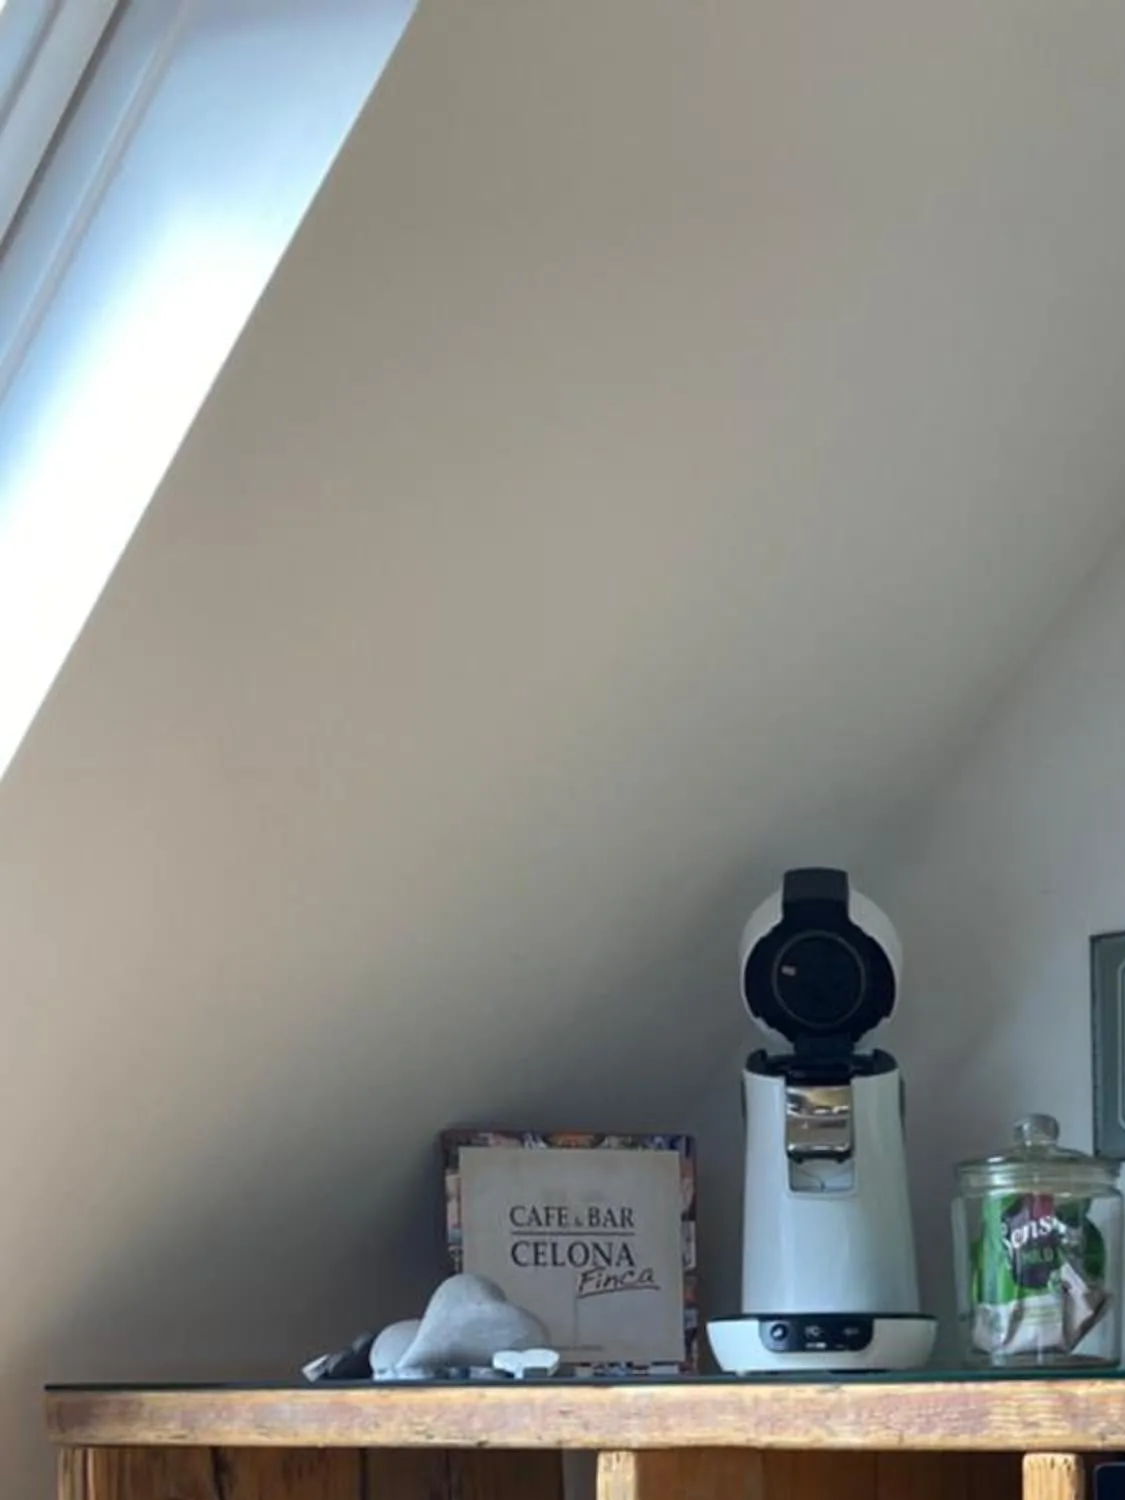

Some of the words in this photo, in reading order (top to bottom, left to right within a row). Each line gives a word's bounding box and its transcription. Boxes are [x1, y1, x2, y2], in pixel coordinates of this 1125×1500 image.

[509, 1205, 569, 1228] CAFE
[587, 1206, 635, 1228] BAR
[510, 1240, 636, 1268] CELONA
[577, 1267, 656, 1292] Finca
